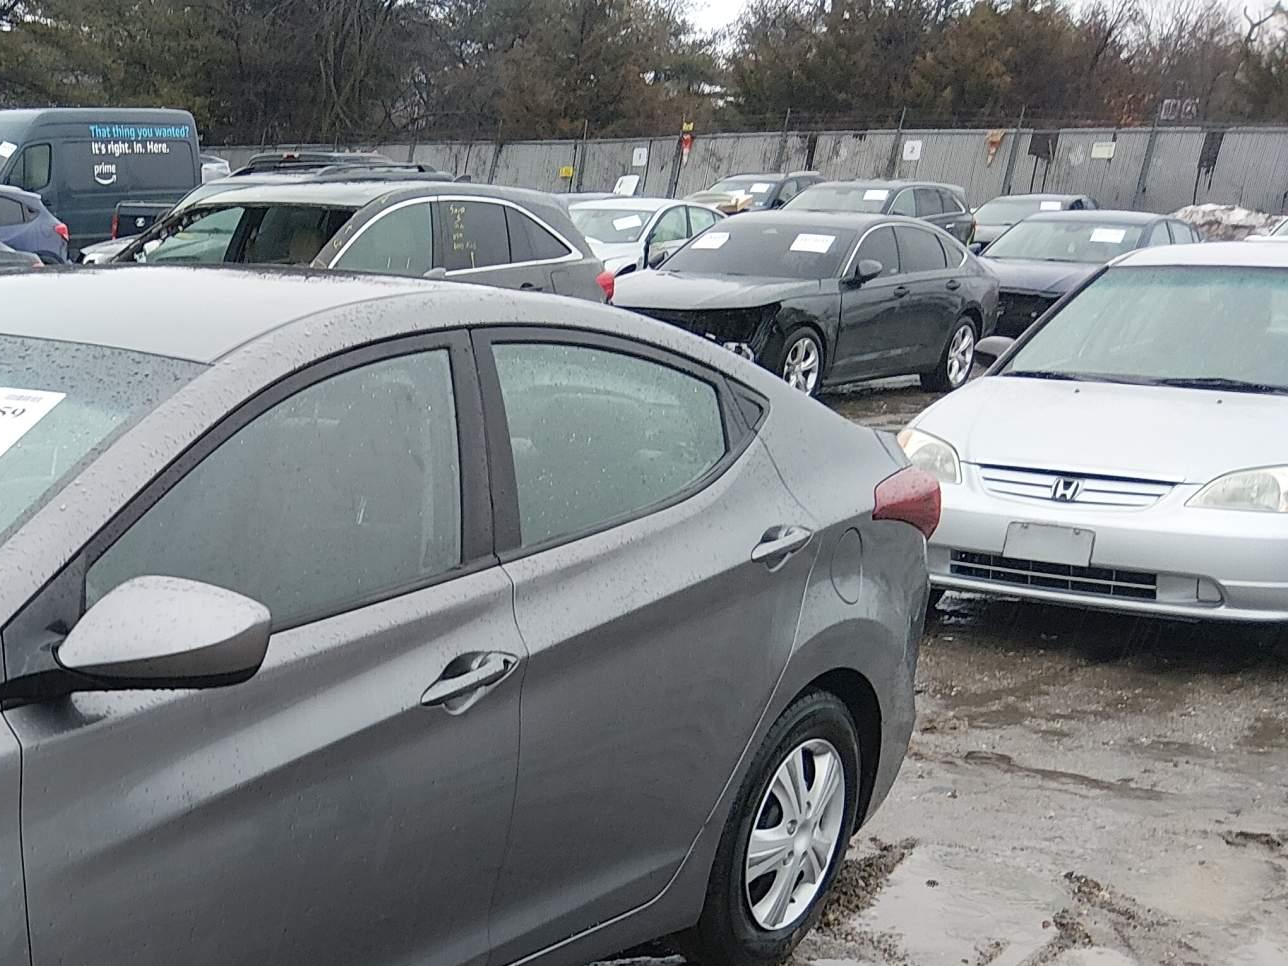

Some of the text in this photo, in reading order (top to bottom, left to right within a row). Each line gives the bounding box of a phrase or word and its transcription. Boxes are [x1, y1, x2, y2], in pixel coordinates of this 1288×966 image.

[89, 125, 190, 140] That thing you wanted?
[92, 140, 170, 157] It's right. In. Here.
[94, 162, 116, 175] prime
